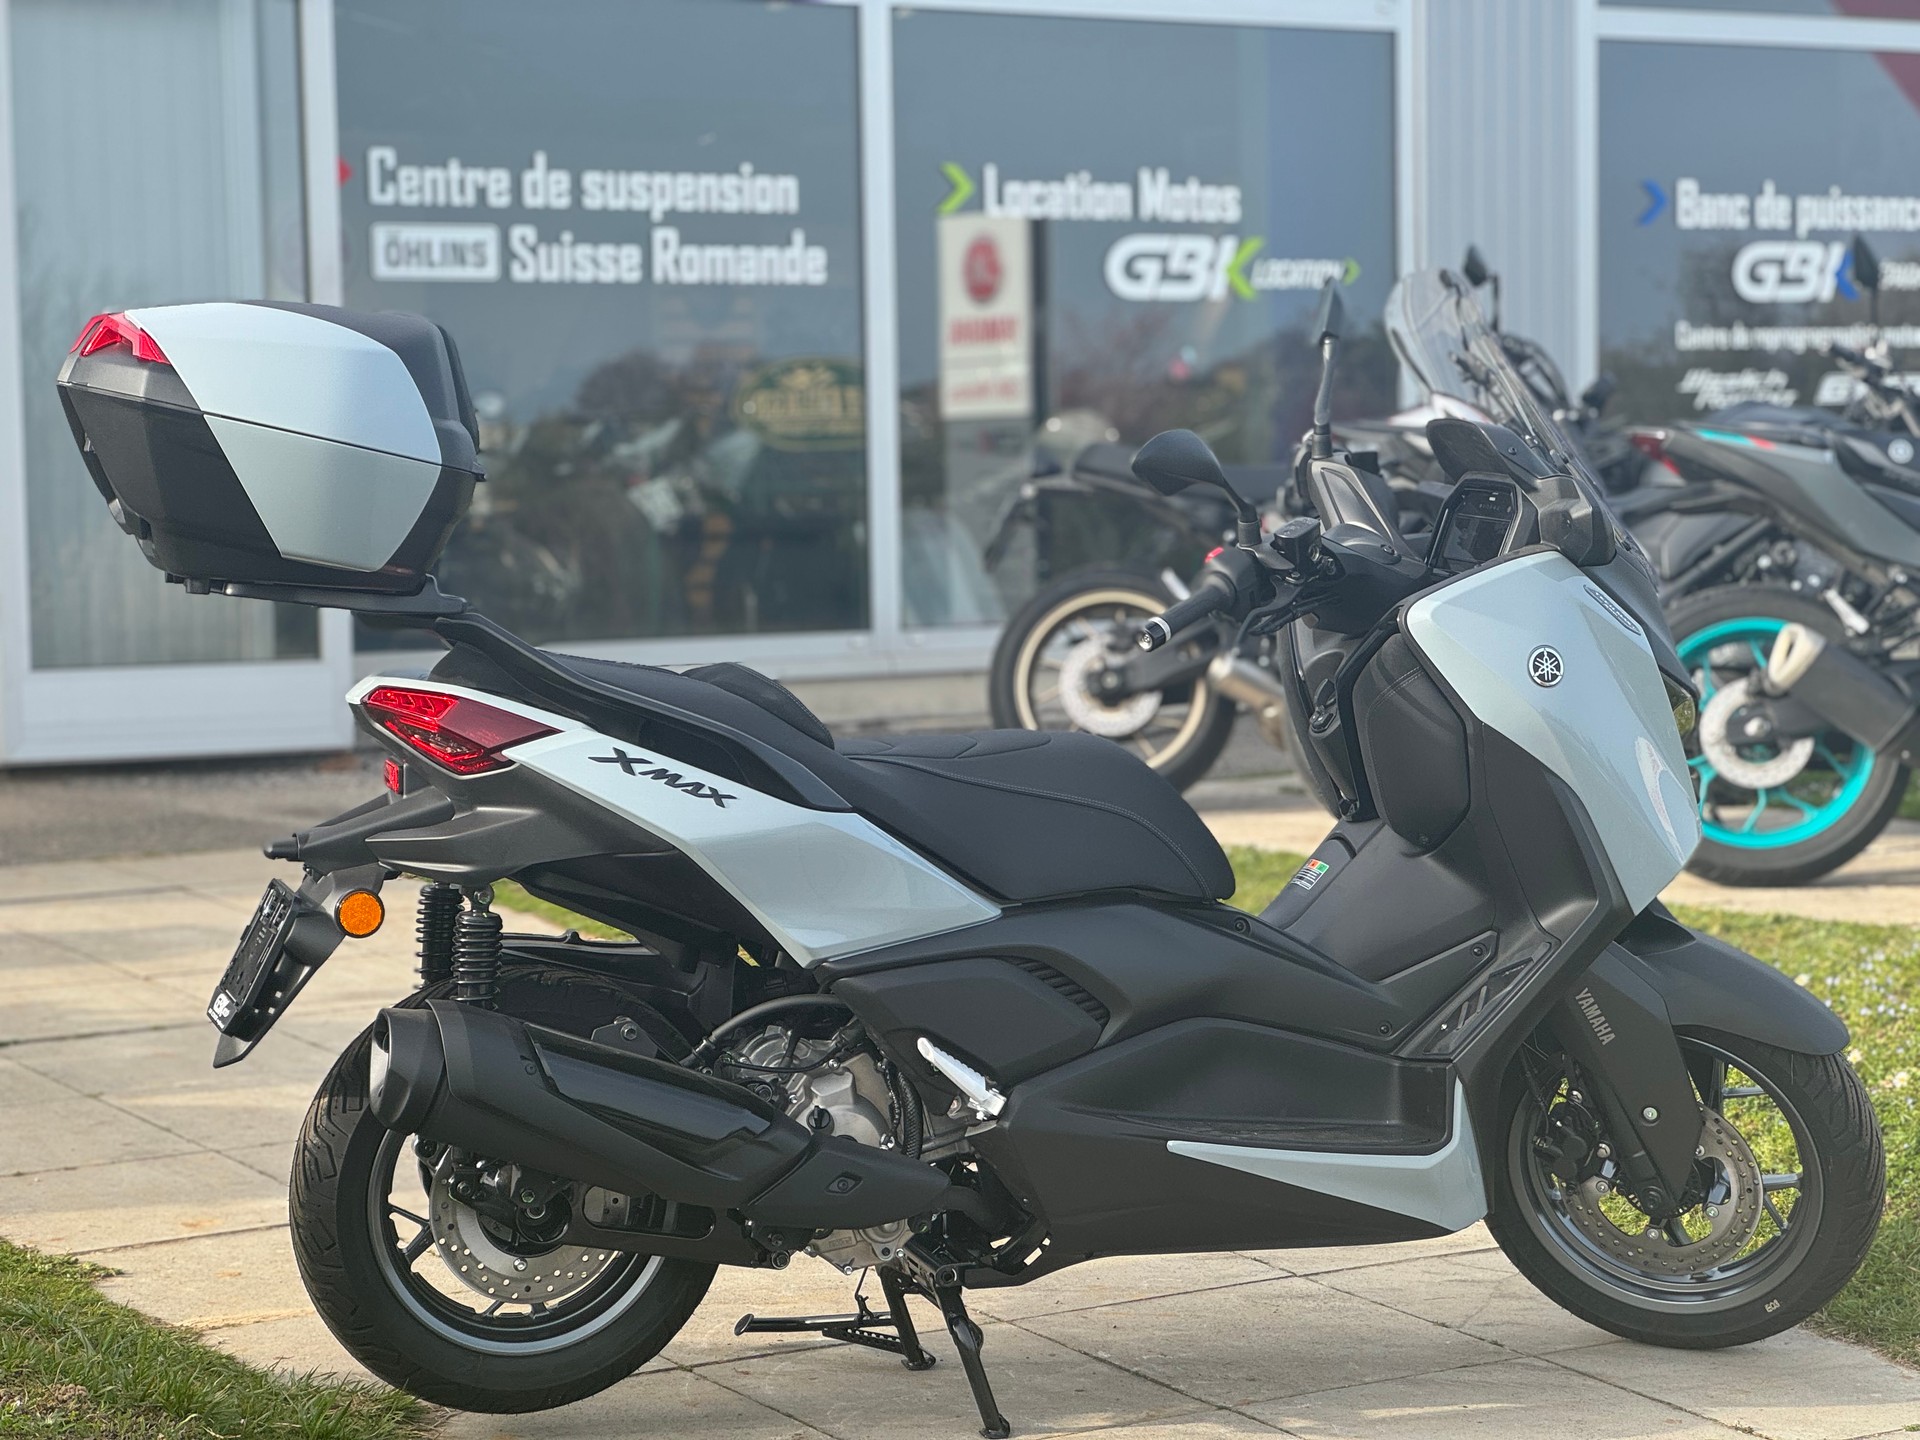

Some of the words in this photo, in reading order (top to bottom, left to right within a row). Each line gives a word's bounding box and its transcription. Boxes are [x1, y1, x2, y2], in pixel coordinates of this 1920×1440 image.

[367, 146, 511, 207] Centre
[521, 150, 571, 209] de
[580, 162, 799, 222] suspension
[983, 163, 1133, 221] Location
[1138, 167, 1242, 223] Motos
[1675, 177, 1750, 230] Banc
[1754, 179, 1792, 230] de
[509, 223, 642, 283] Suisse
[651, 226, 828, 285] Romande
[1250, 259, 1344, 290] LOCATION
[1575, 987, 1616, 1046] YAMAHA
